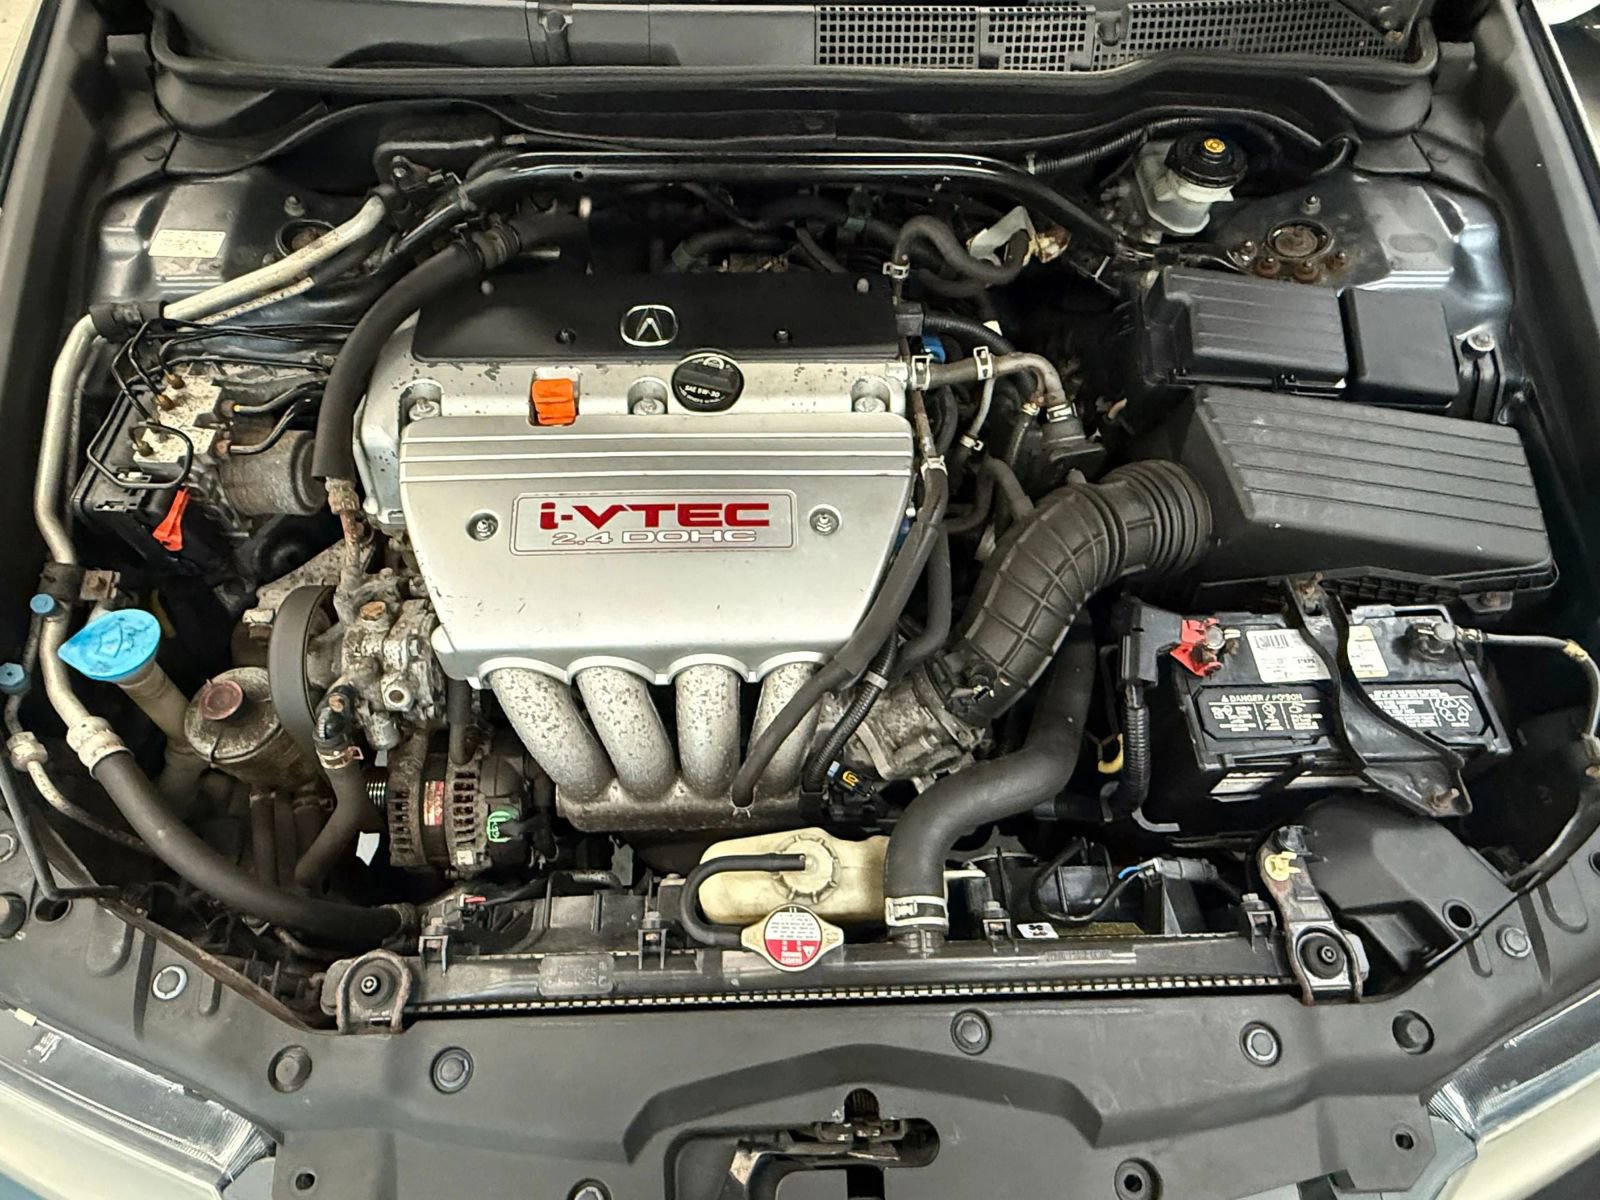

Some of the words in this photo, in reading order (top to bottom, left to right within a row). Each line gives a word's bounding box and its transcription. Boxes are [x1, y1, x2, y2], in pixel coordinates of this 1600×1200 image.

[540, 502, 769, 530] i-VTEC
[551, 530, 613, 545] 2.4
[622, 529, 757, 543] DOHC
[1229, 694, 1264, 702] DANGER
